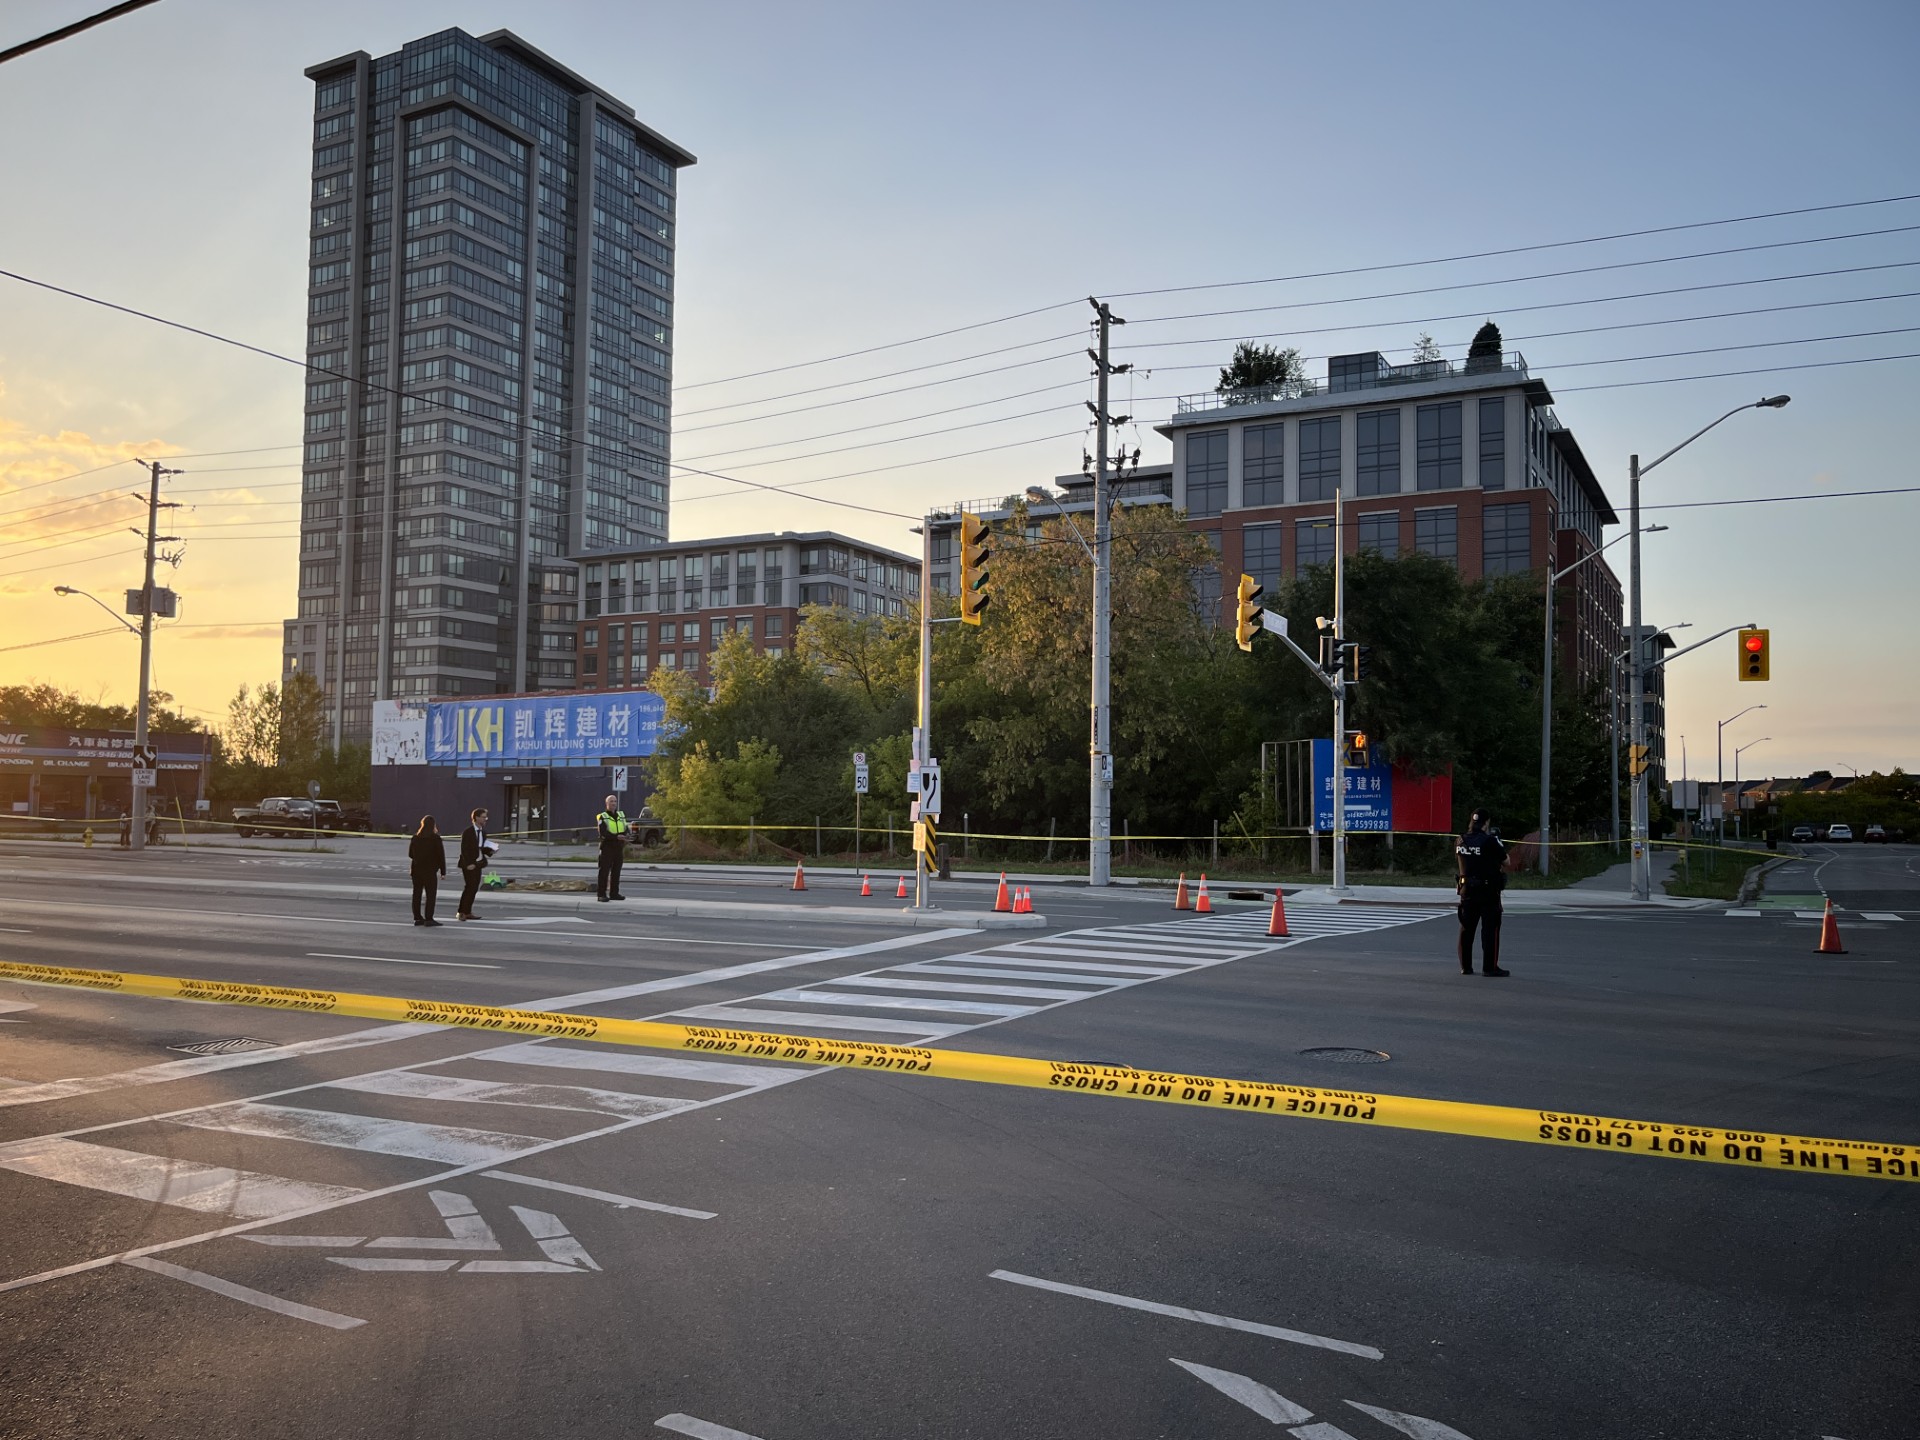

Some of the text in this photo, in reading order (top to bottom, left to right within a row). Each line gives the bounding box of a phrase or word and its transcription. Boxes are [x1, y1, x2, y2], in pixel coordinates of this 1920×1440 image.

[515, 704, 631, 738] 凯辉建材
[545, 739, 584, 750] BUILDING
[587, 738, 629, 748] SUPPLIES
[857, 776, 867, 788] 50
[174, 989, 336, 1011] POLICE LINE DO NOT CROSS
[310, 991, 337, 1002] Crime
[402, 1011, 597, 1038] POLICE LINE DO NOT CROSS
[406, 1000, 598, 1027] Crime Stoppers 1-800-222-8477 (TIPS)
[682, 1038, 932, 1071] POLICE LINE DO NOT CROSS
[685, 1027, 932, 1059] Crime Stoppers 1-800-222-8477 (TIPS)
[1050, 1062, 1376, 1104] Crime Stoppers 1-800-222-8477 (TIPS)
[1048, 1074, 1376, 1120] POLICE LINE DO NOT CROSS
[1538, 1111, 1601, 1127] (TIPS)
[1538, 1124, 1633, 1148] CROSS
[1648, 1136, 1707, 1156] NOT
[1723, 1143, 1762, 1162] DO
[1779, 1149, 1849, 1170] LINE
